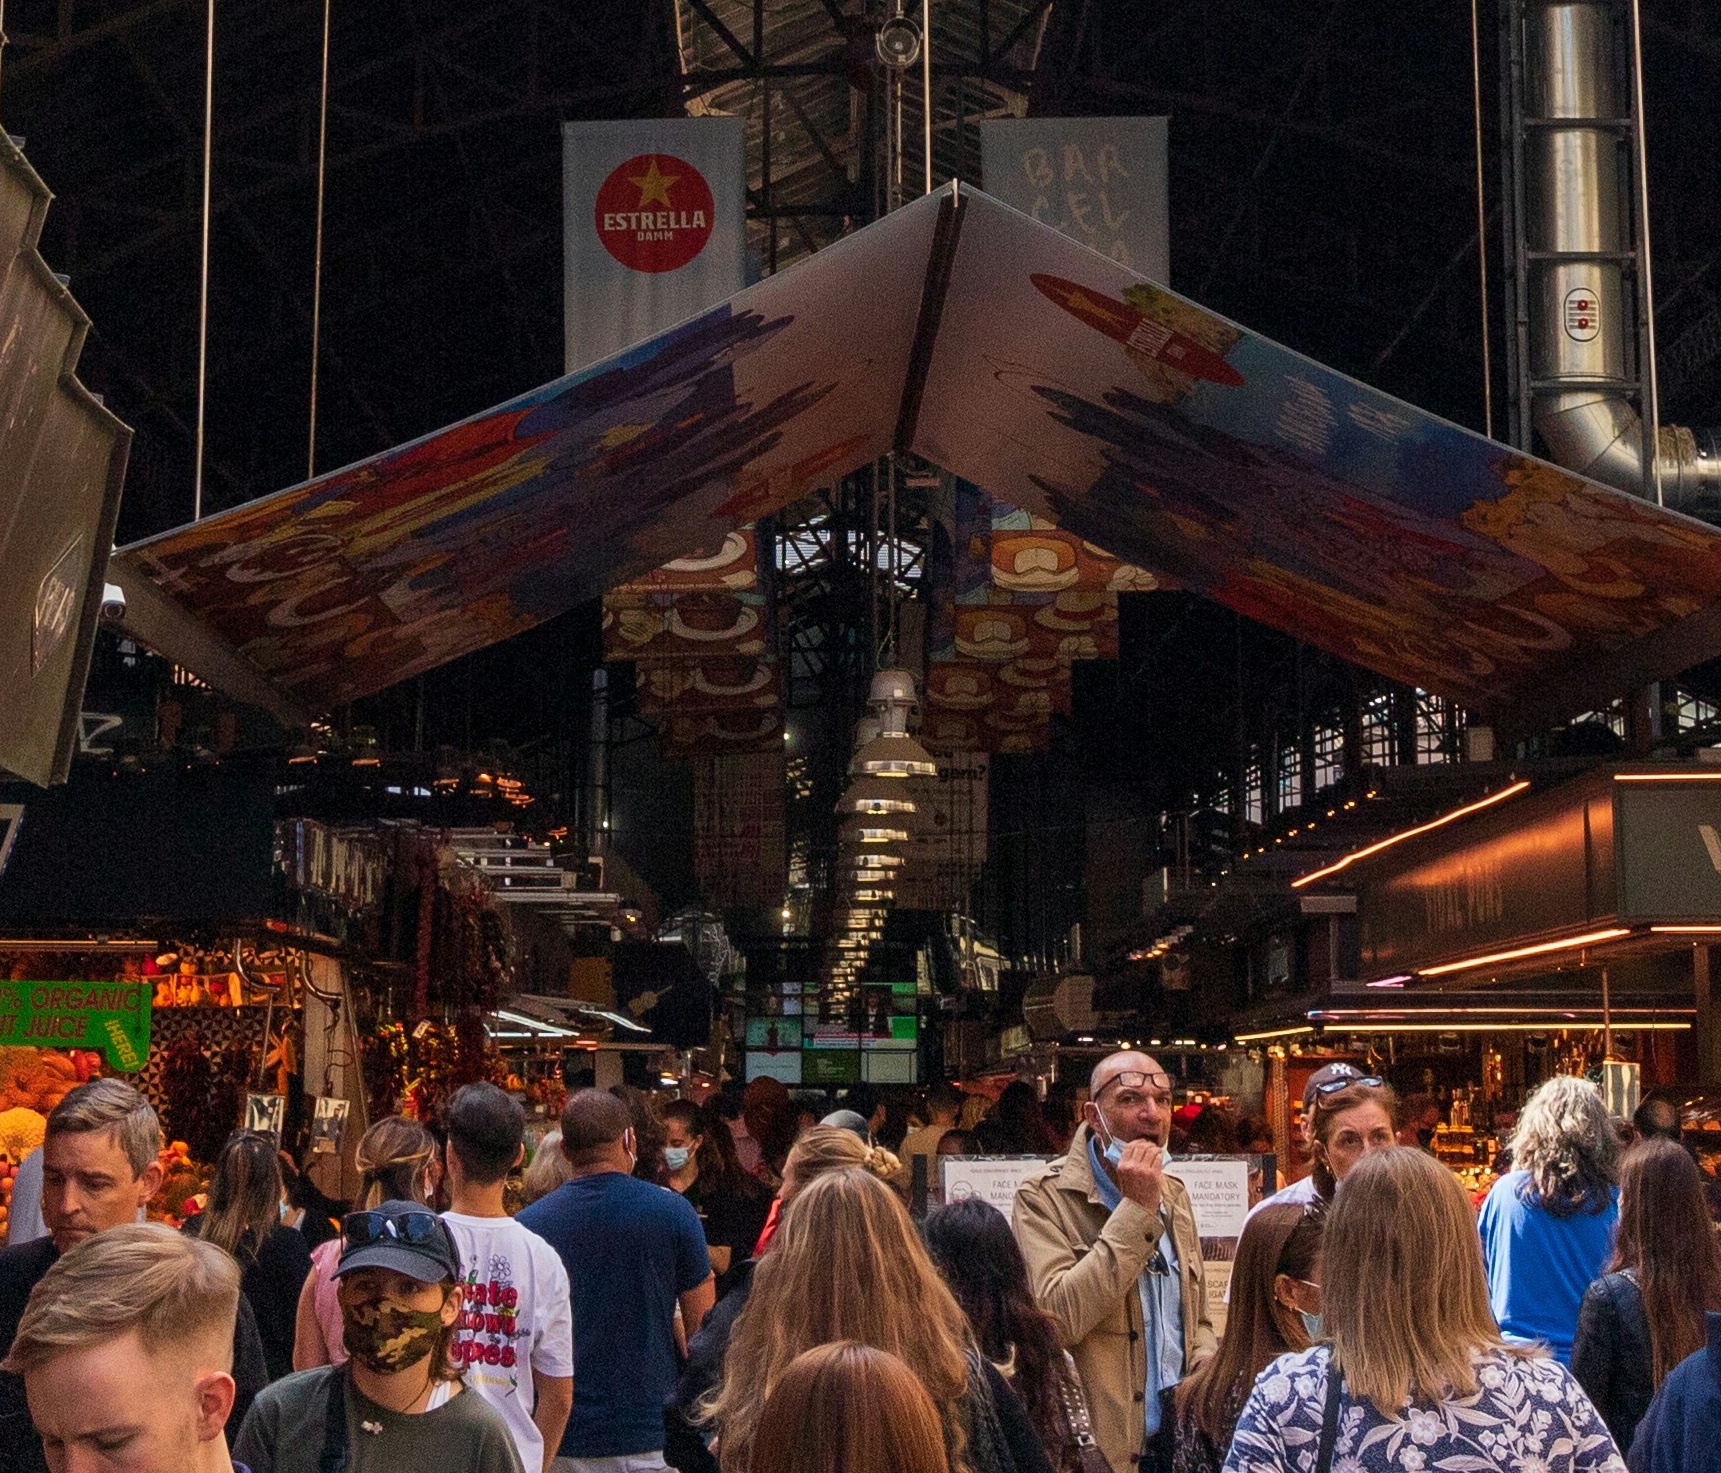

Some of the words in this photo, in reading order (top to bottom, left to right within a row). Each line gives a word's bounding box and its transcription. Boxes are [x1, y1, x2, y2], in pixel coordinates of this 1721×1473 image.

[604, 209, 706, 231] ESTRELLA
[636, 230, 674, 242] DAMM
[29, 985, 142, 1012] ORGANIC
[22, 1015, 90, 1040] JUICE
[1194, 1180, 1212, 1189] FACE
[1215, 1180, 1238, 1189] MASK
[1191, 1192, 1241, 1201] MANDATORY
